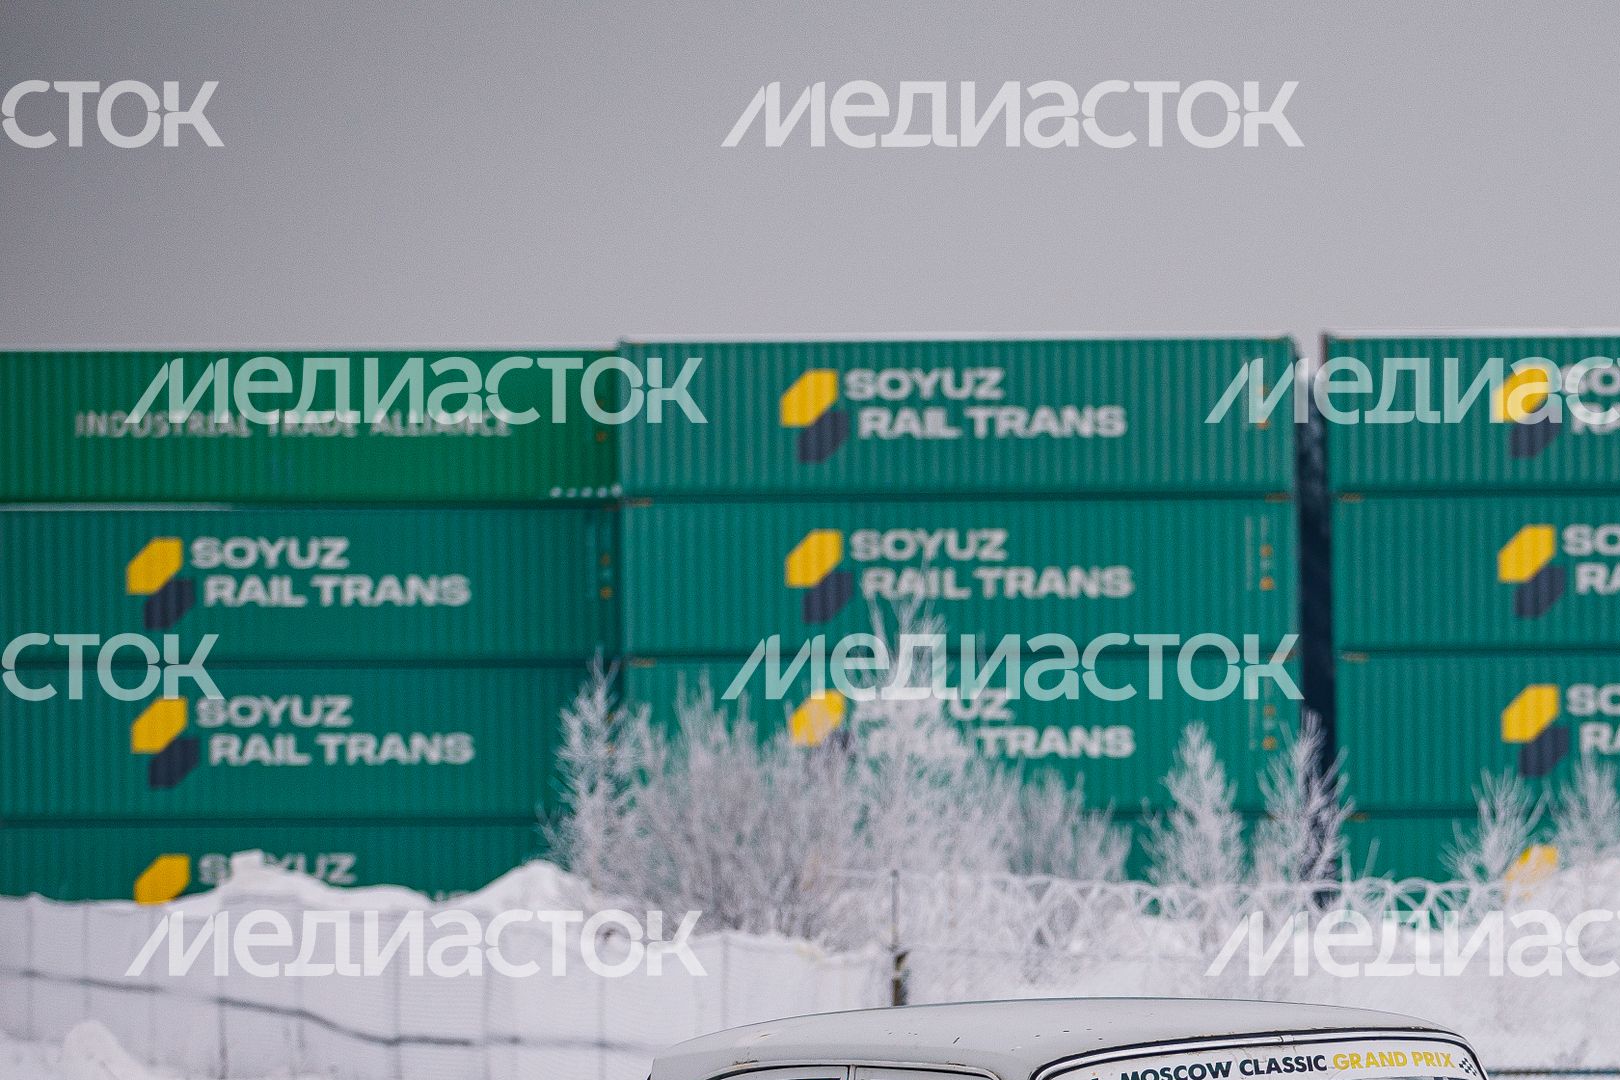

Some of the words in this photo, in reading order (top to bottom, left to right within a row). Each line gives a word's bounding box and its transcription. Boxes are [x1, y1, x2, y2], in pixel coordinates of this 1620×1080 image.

[844, 366, 1005, 400] SOYUZ
[75, 409, 251, 439] INDUSTRIAL
[267, 409, 358, 439] TRADE
[857, 406, 961, 439] RAIL
[964, 404, 1127, 438] TRANS
[190, 537, 349, 568] SOYUZ
[849, 528, 1009, 561] SOYUZ
[203, 575, 306, 607] RAIL
[311, 574, 471, 606] TRANS
[860, 567, 971, 600] RAIL
[973, 565, 1134, 598] TRANS
[195, 696, 352, 727] SOYUZ
[208, 733, 310, 766] RAIL
[316, 732, 475, 764] TRANS
[976, 725, 1136, 759] TRANS
[198, 852, 357, 885] SYUZ
[1238, 1054, 1328, 1076] CLASSIC
[1332, 1051, 1409, 1071] GRAND
[1412, 1050, 1456, 1069] PRIX
